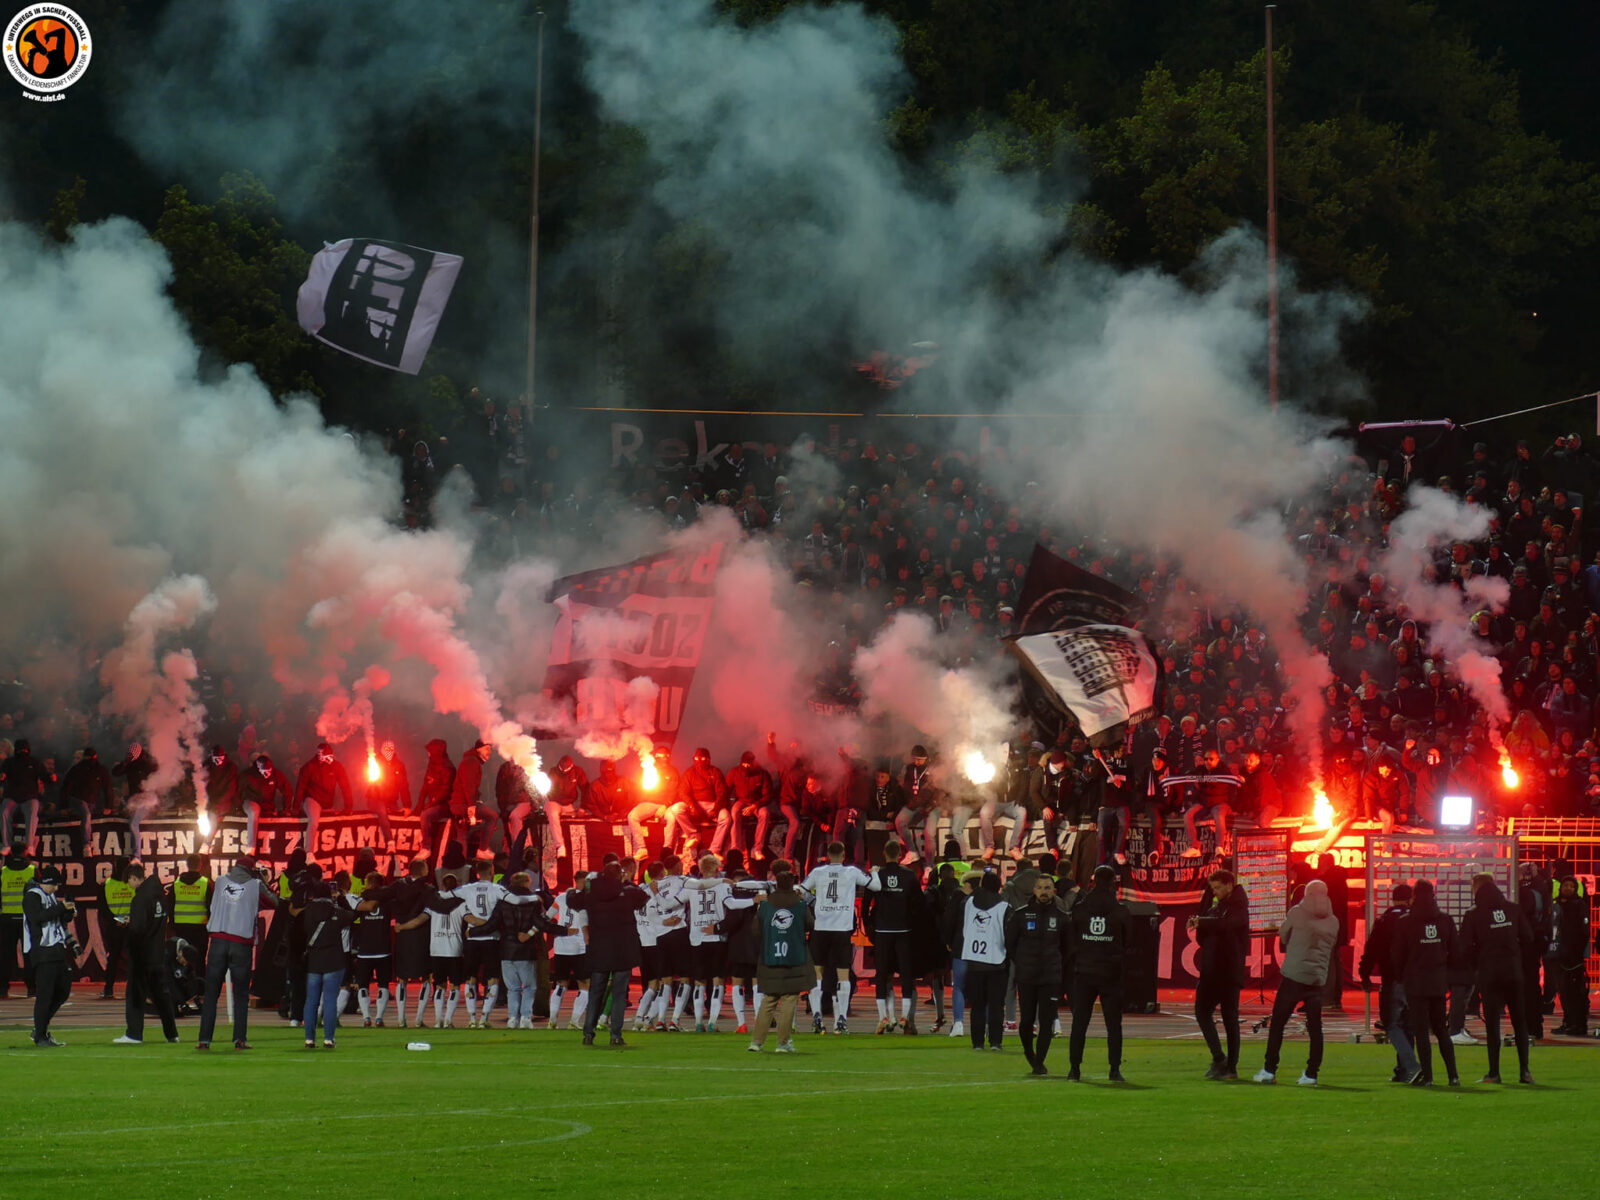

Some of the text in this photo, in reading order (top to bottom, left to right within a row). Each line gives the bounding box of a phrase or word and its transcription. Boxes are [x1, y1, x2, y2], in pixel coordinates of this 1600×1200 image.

[826, 880, 839, 903] 4
[476, 893, 488, 917] 9
[698, 890, 717, 915] 32
[972, 940, 988, 954] 02
[1082, 934, 1114, 942] Husqvarna
[774, 941, 788, 957] 10
